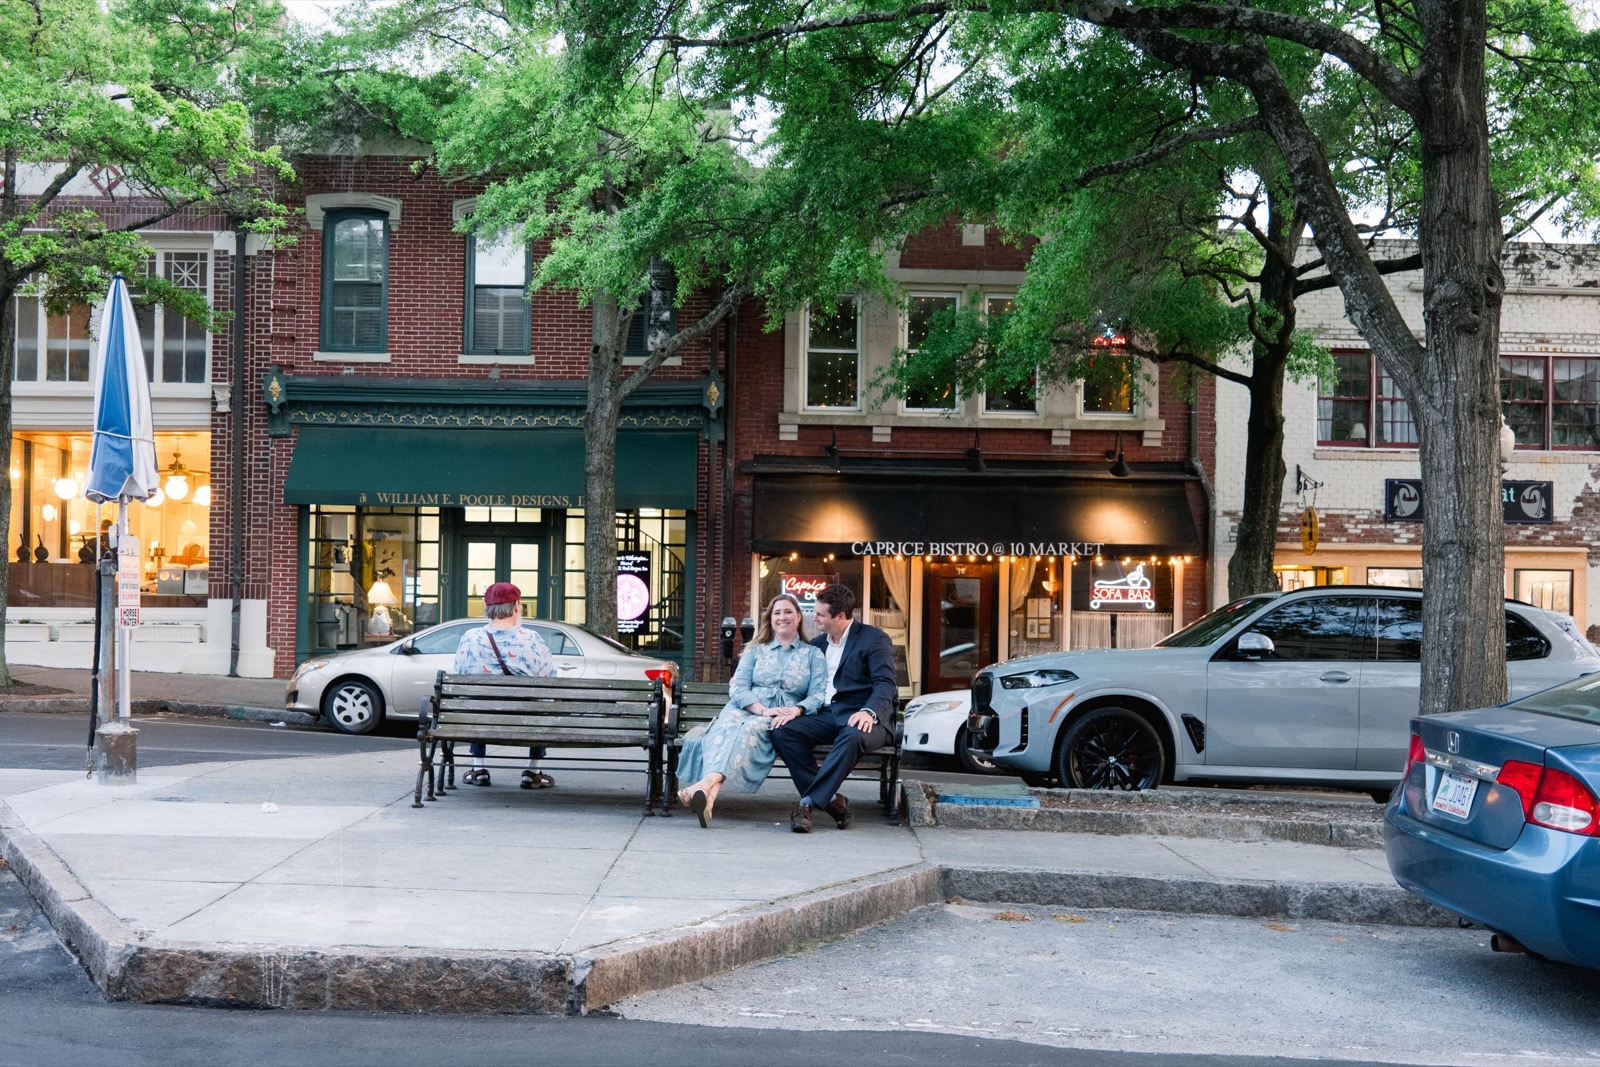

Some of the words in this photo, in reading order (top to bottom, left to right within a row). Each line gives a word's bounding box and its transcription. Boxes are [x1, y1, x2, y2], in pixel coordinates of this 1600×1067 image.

[376, 492, 439, 504] WILLIAM
[442, 493, 454, 504] E.
[458, 494, 506, 506] POOLE
[511, 495, 573, 508] DESIGNS,
[1502, 487, 1515, 502] at
[851, 541, 925, 556] CAPRICE
[929, 542, 989, 556] BISTRO
[992, 542, 1005, 556] @
[1009, 542, 1025, 556] 10
[1029, 542, 1105, 556] MARKET
[785, 577, 828, 594] Caprice
[1092, 588, 1123, 600] SOFA
[1127, 588, 1152, 600] BAR
[123, 608, 137, 617] HORSE
